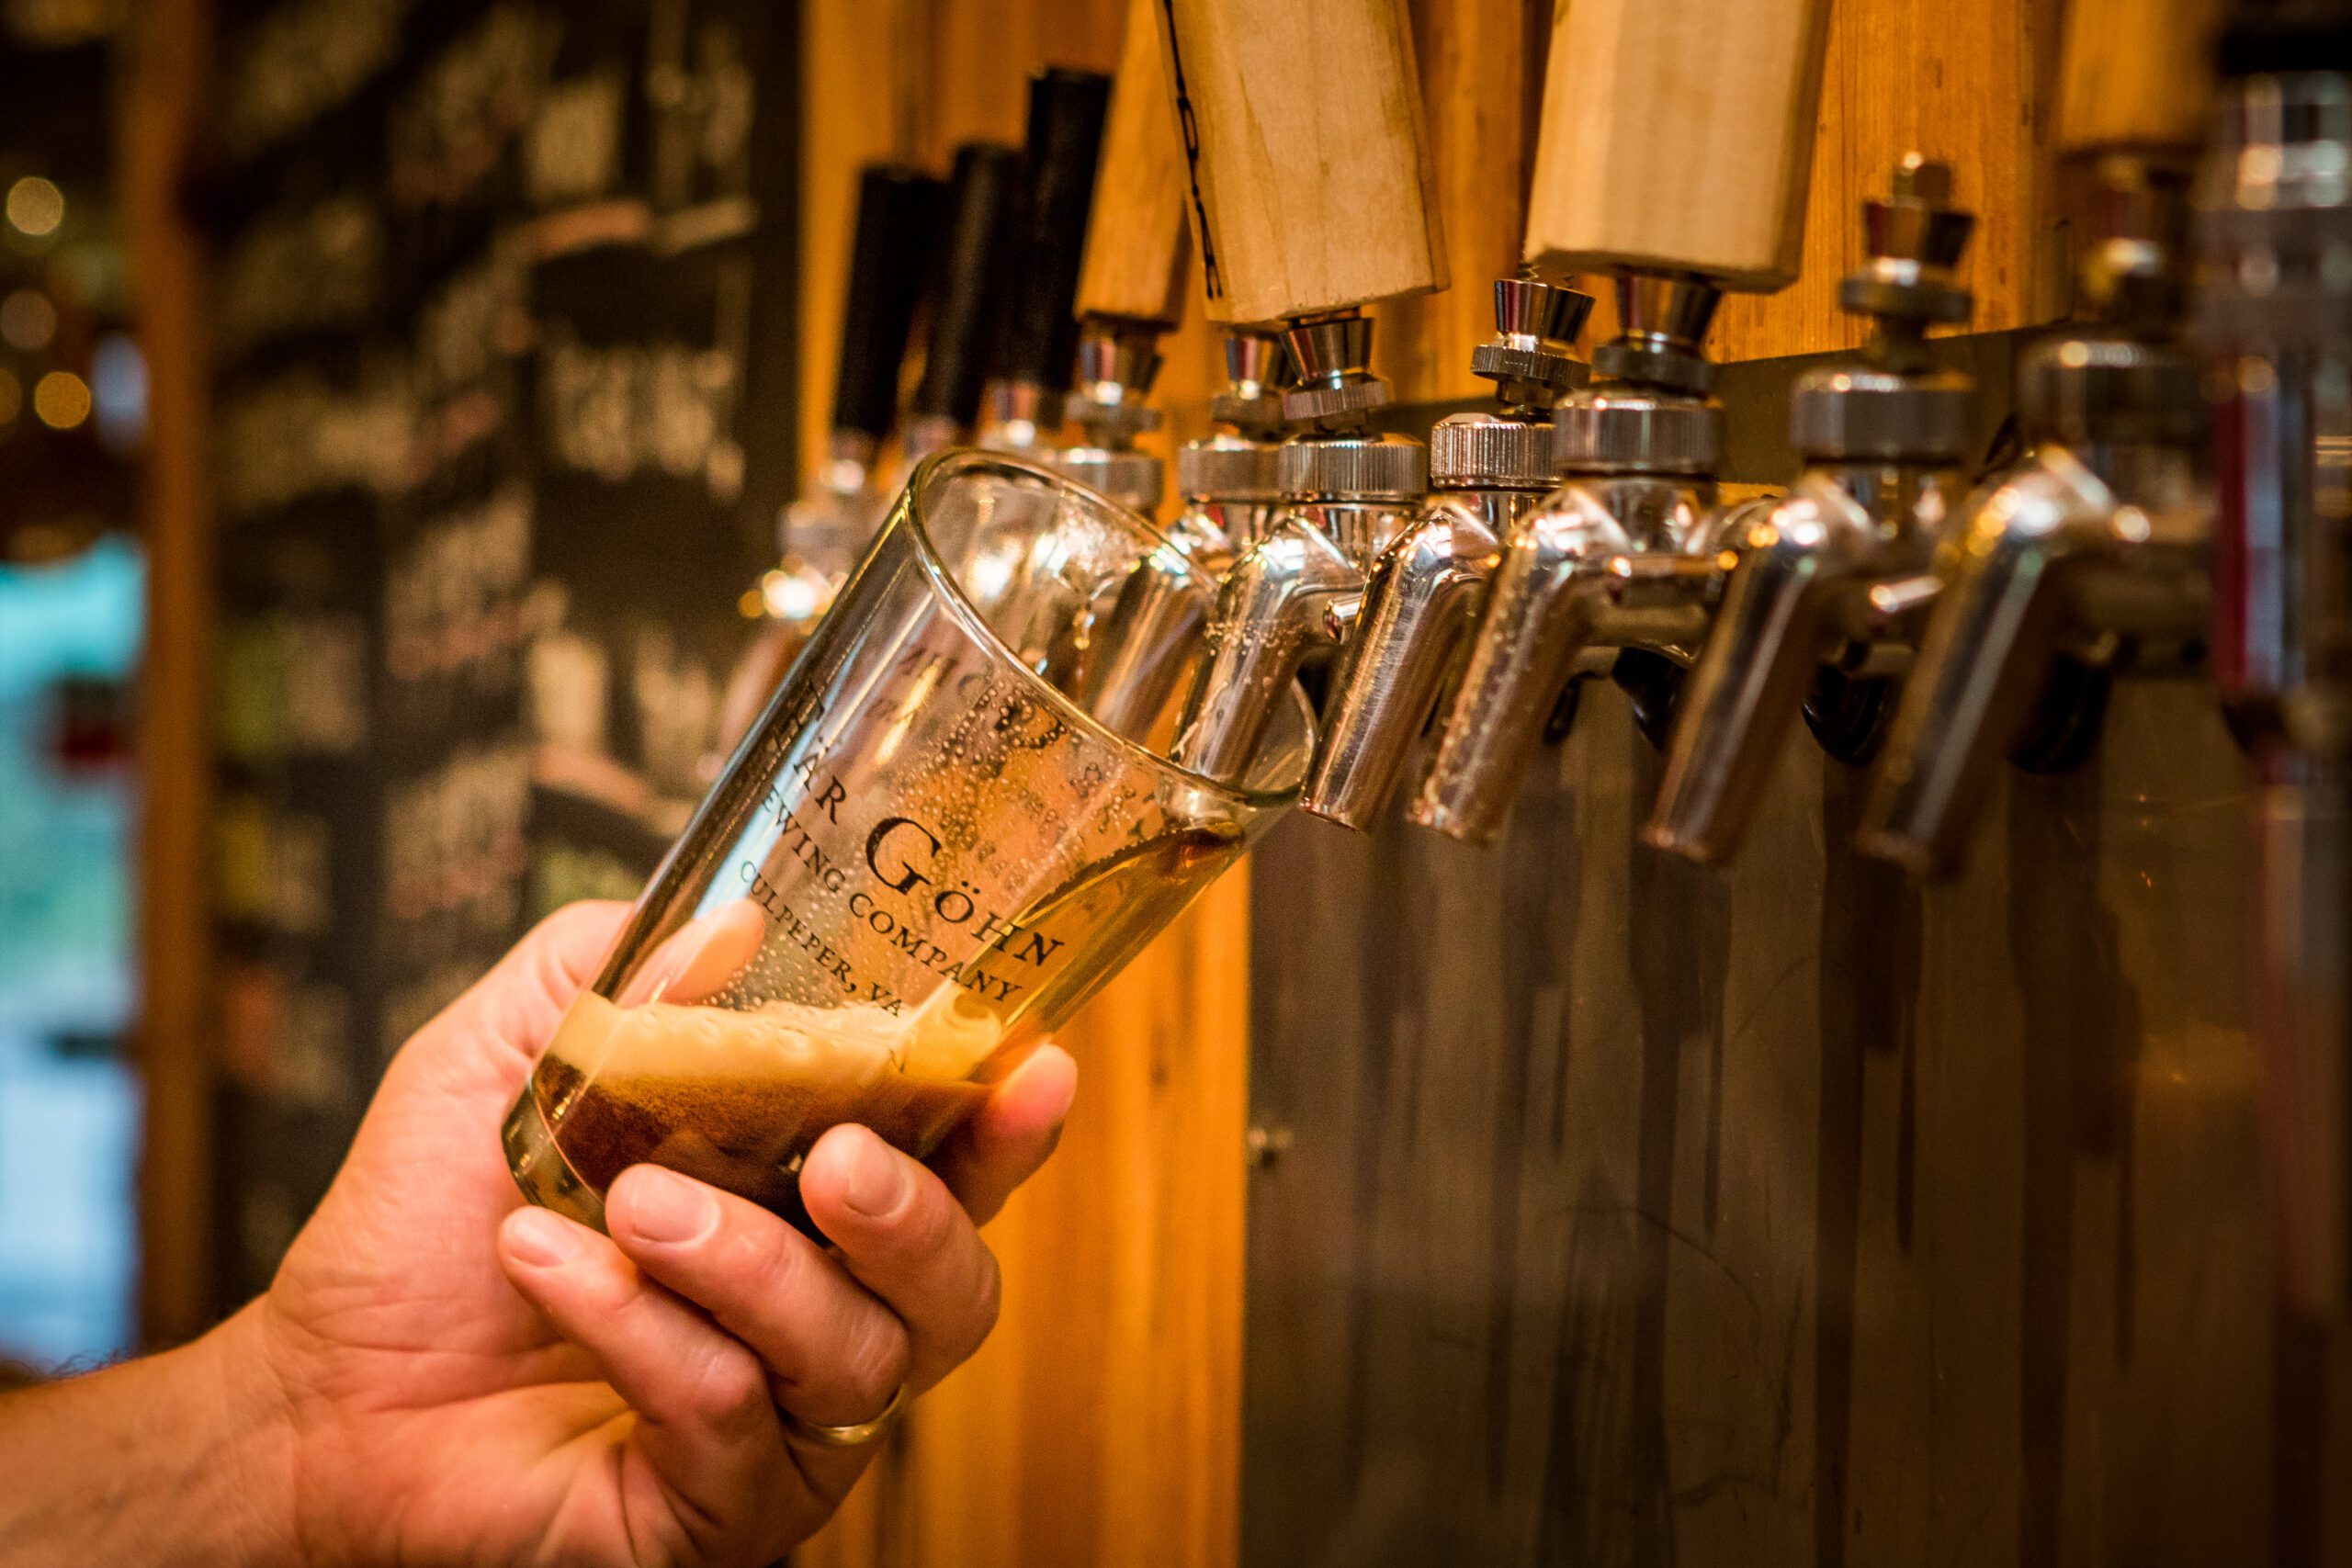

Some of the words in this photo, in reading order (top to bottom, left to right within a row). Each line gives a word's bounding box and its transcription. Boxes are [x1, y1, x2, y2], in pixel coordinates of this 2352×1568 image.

[741, 860, 857, 994] CULPEPER,
[871, 980, 904, 1018] VA
[762, 783, 846, 895] EWING
[848, 892, 1023, 1001] COMPANY
